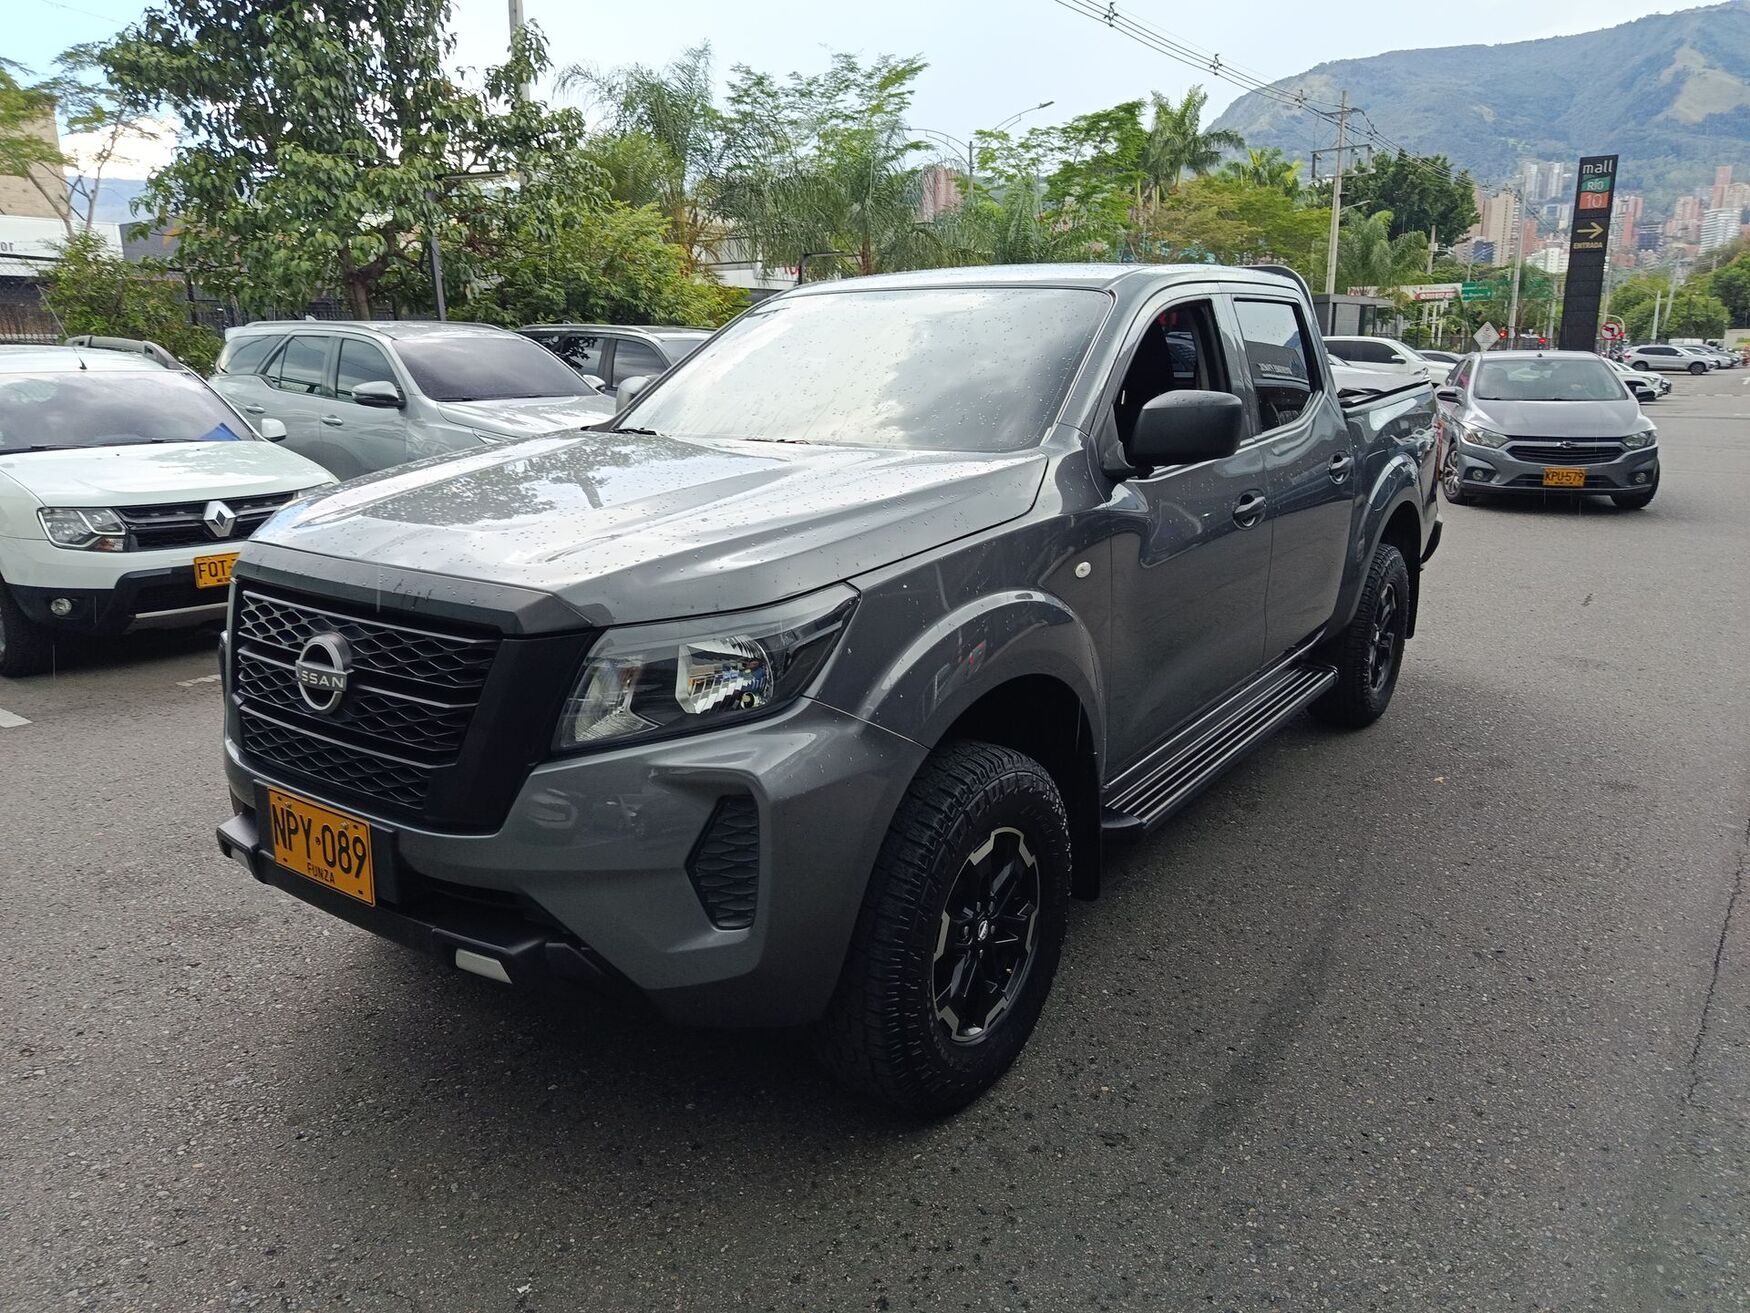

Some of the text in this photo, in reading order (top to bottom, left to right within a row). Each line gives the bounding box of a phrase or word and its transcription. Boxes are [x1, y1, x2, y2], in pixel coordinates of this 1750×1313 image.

[1582, 160, 1613, 174] mall
[1586, 193, 1602, 208] 10
[307, 862, 336, 885] FUNZA
